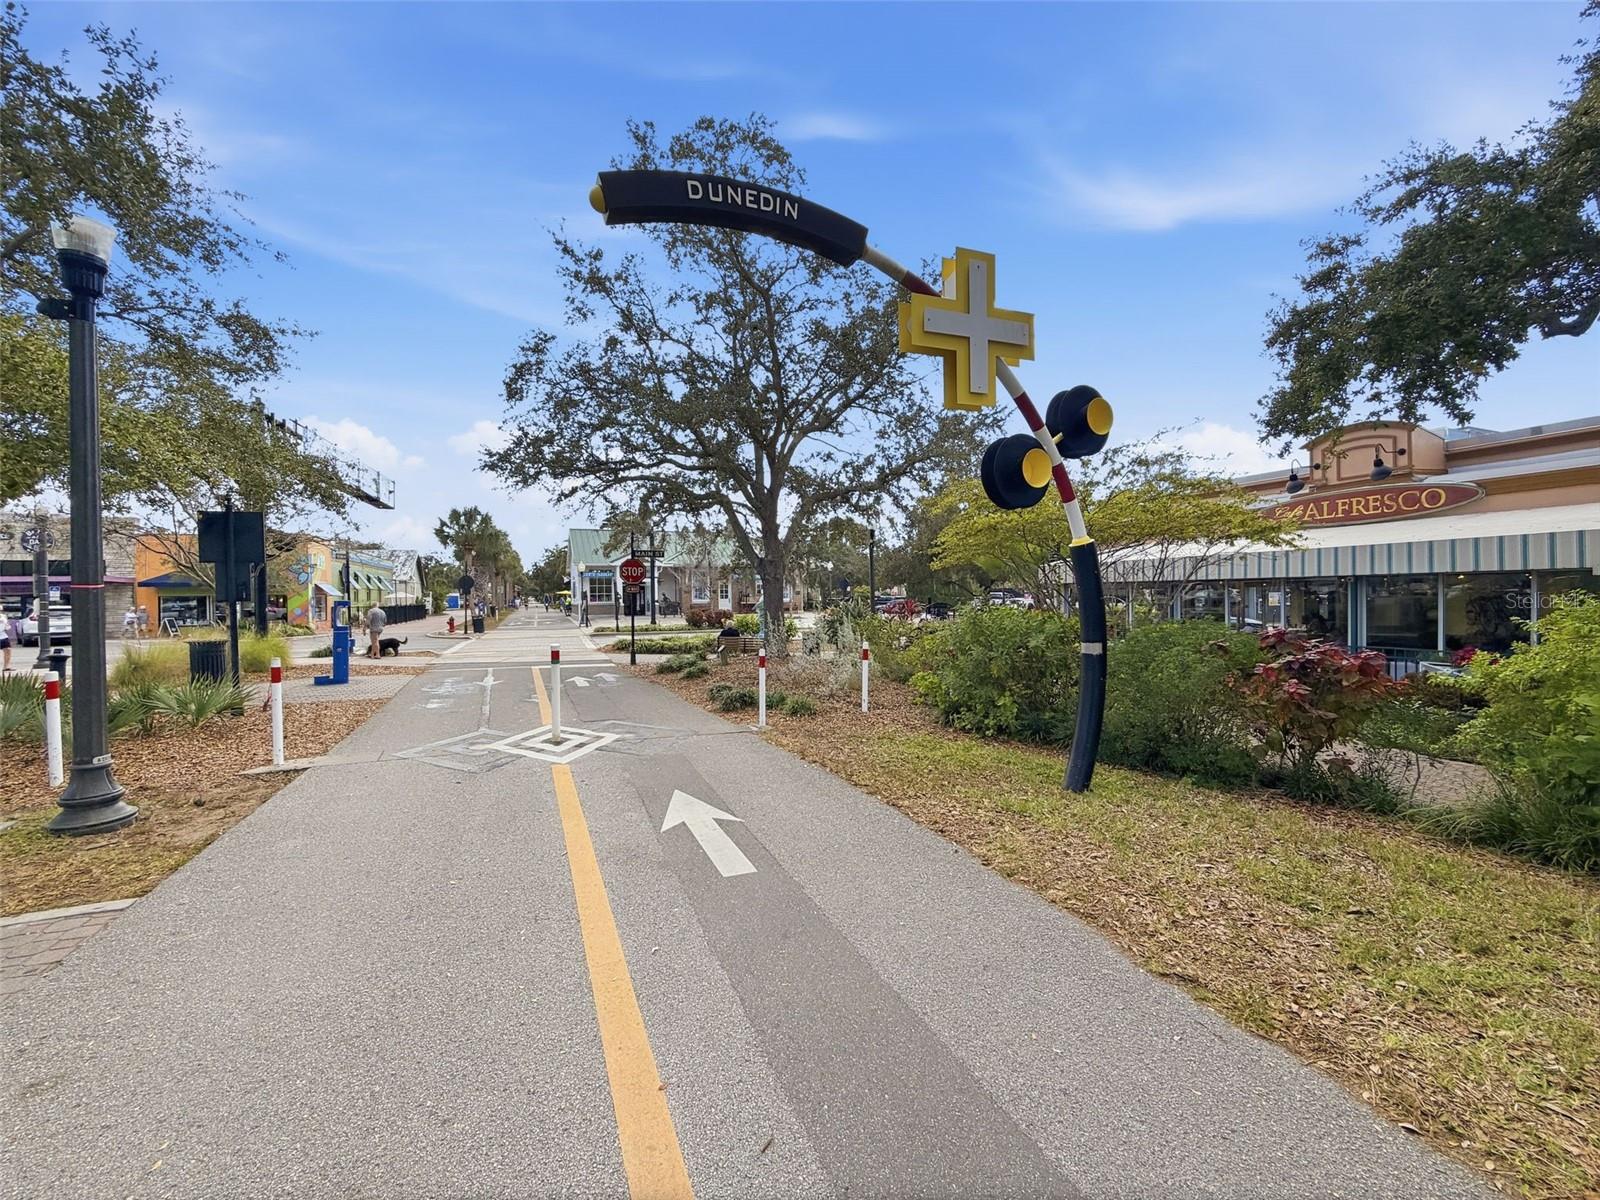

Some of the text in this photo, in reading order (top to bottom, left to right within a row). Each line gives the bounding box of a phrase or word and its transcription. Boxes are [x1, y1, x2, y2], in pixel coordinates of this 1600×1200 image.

[686, 180, 799, 220] DUNEDIN
[1303, 488, 1447, 521] ALFRESCO
[622, 567, 644, 577] STOP
